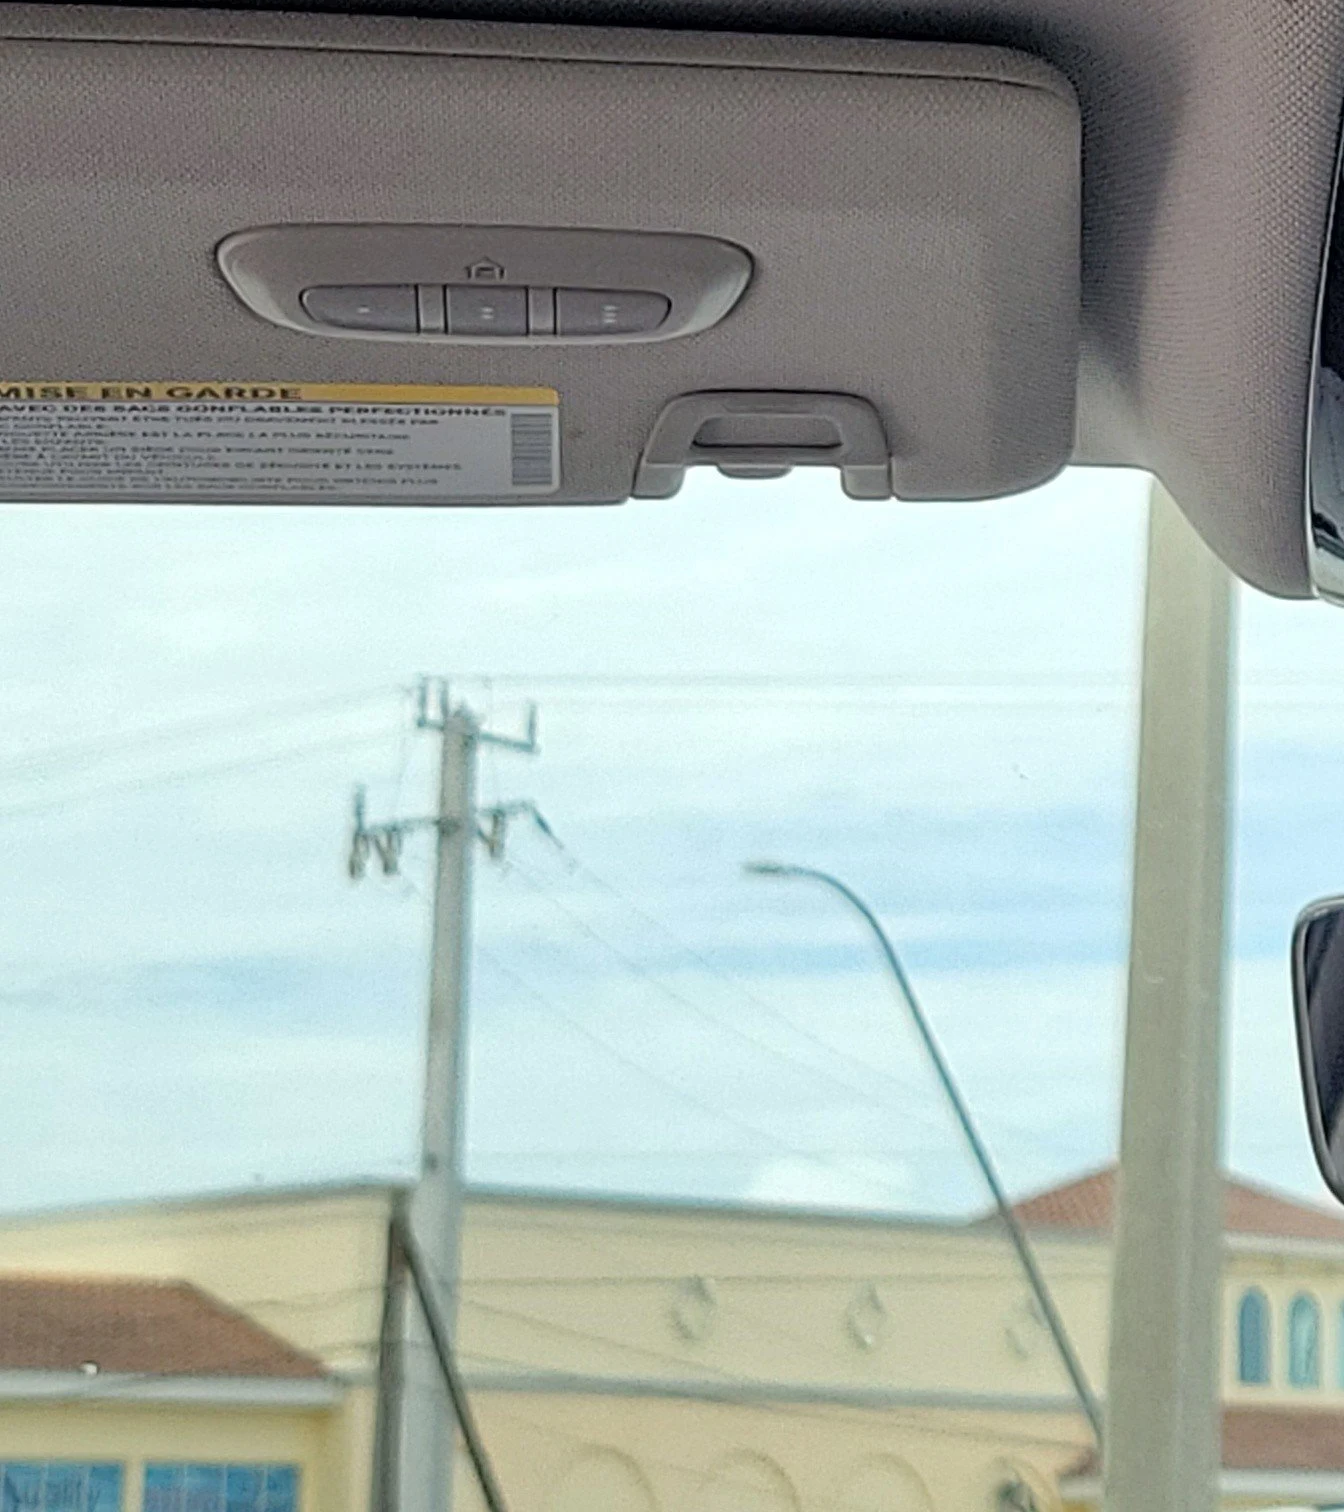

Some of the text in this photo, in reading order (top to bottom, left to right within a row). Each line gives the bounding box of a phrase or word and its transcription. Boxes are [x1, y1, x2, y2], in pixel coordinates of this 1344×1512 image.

[0, 386, 302, 400] MISE EN GARDE
